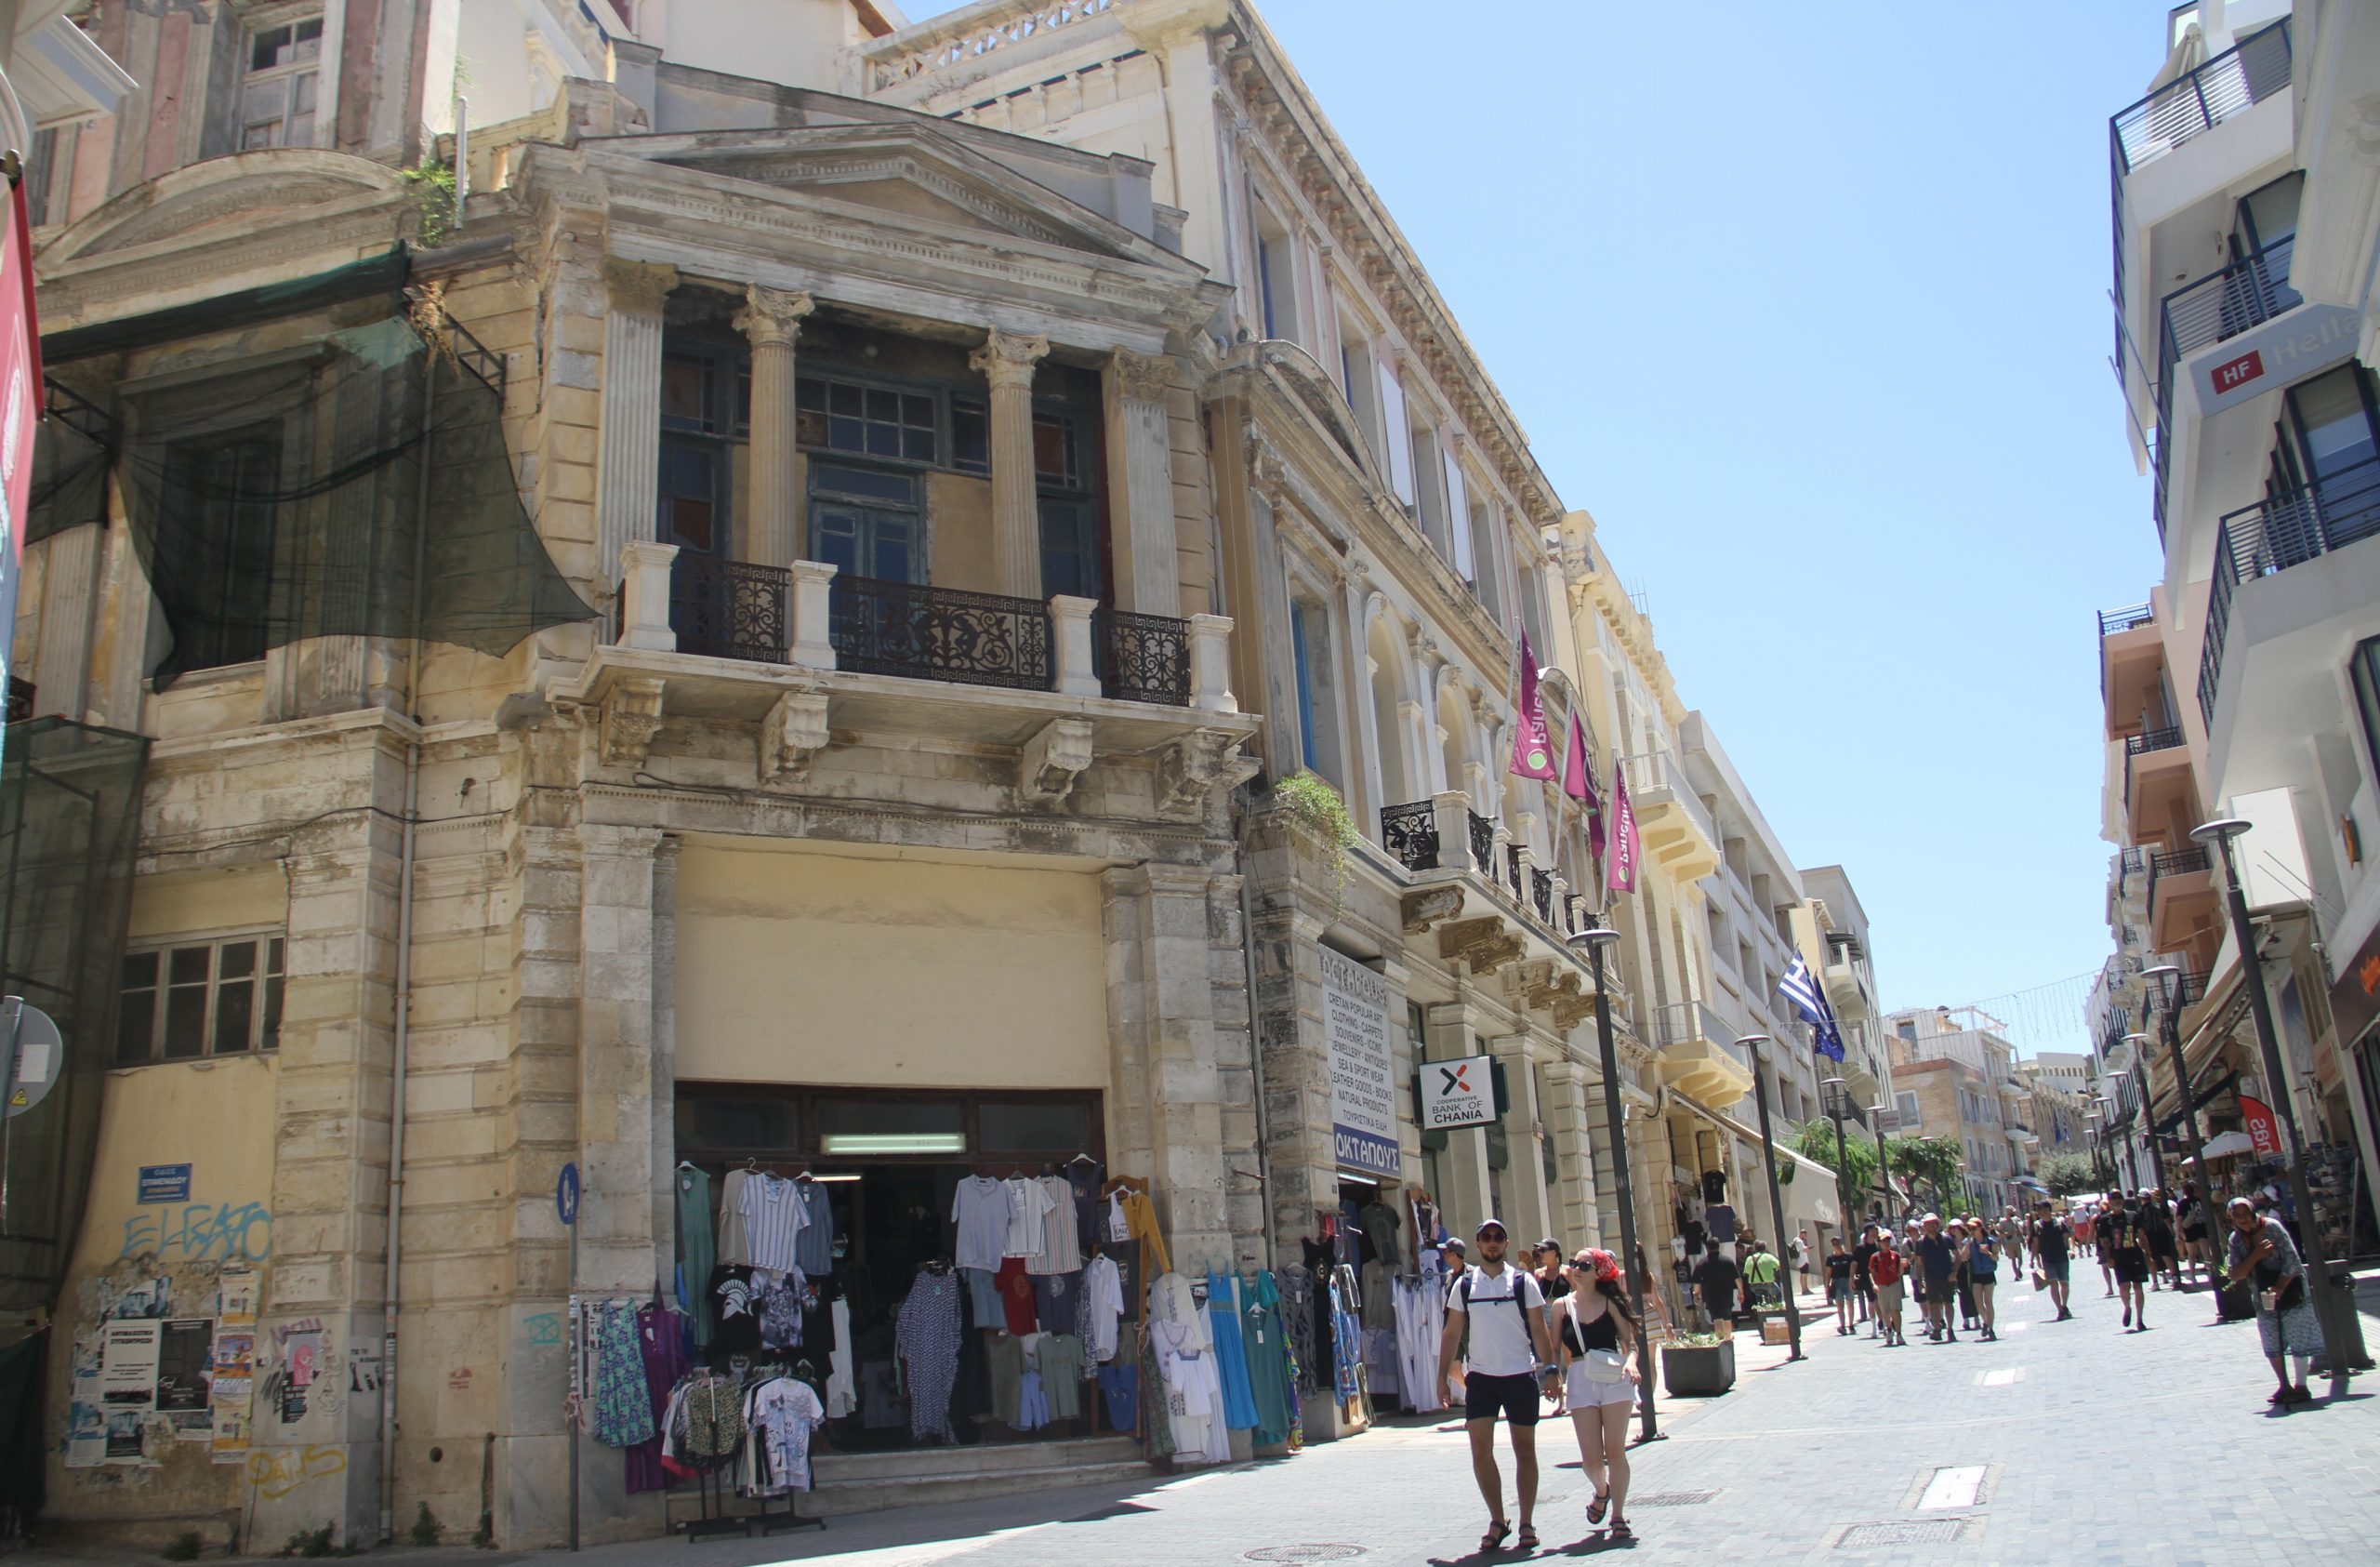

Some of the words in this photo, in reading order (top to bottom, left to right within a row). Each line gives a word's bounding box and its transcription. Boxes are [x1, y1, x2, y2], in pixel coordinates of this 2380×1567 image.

[2223, 361, 2250, 385] HF
[1329, 991, 1349, 1011] CRETAN
[1350, 1002, 1372, 1021] POPULAR
[1374, 1012, 1382, 1024] ART
[1331, 1009, 1357, 1029] CLOTHING
[1361, 1022, 1383, 1040] CARPETS
[1335, 1025, 1364, 1047] SOUVENIRS
[1368, 1038, 1382, 1055] ICONS
[1332, 1040, 1360, 1059] JEWELLERY
[1365, 1052, 1388, 1071] ANTIQUES
[1338, 1057, 1348, 1070] SEA
[1354, 1063, 1369, 1078] SPORT
[1370, 1069, 1384, 1084] WEAR
[1331, 1071, 1354, 1088] LEATHER
[1355, 1079, 1372, 1095] GOODS
[1376, 1086, 1393, 1102] BOOKS
[1338, 1089, 1362, 1107] NATURAL
[1362, 1096, 1388, 1115] PRODUCTS
[1432, 1104, 1461, 1114] BANK
[1468, 1100, 1484, 1109] OF
[1436, 1096, 1477, 1105] COOPERATIVE
[1342, 1109, 1375, 1128] ΤΟΥΡΙΣΤΙΚΑ
[1434, 1109, 1484, 1123] CHANIA
[1335, 1132, 1400, 1172] ΟΚΤΑΠΟΥΣ
